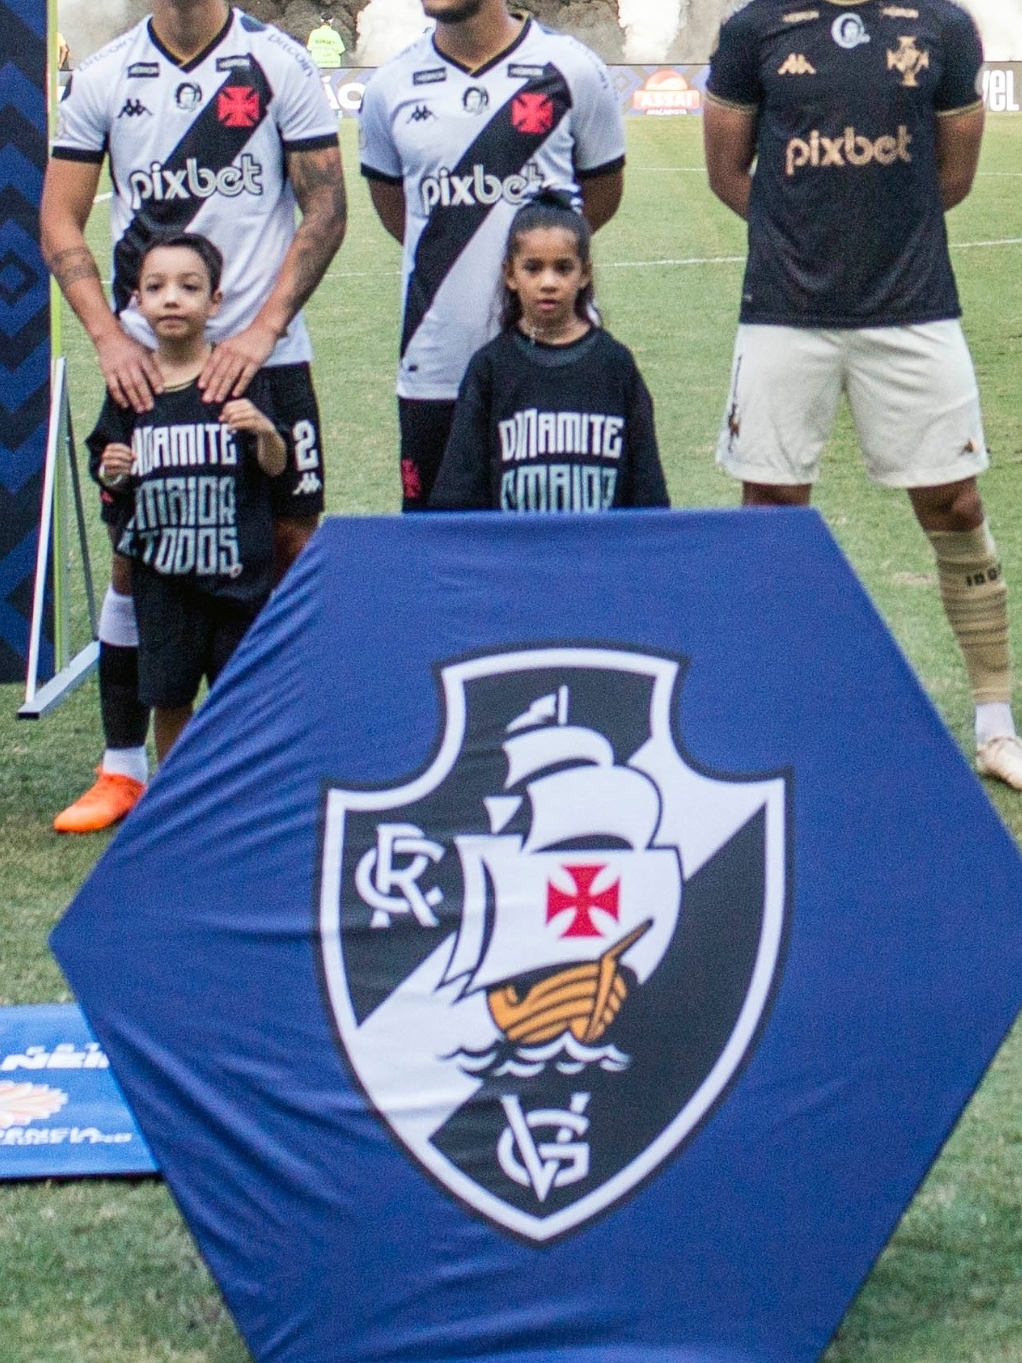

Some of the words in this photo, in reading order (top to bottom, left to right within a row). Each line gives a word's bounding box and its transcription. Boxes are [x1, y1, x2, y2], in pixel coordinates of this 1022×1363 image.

[786, 125, 913, 177] pixbet
[129, 153, 263, 211] pixbet
[292, 419, 319, 472] 2
[498, 408, 625, 462] DINAMITE
